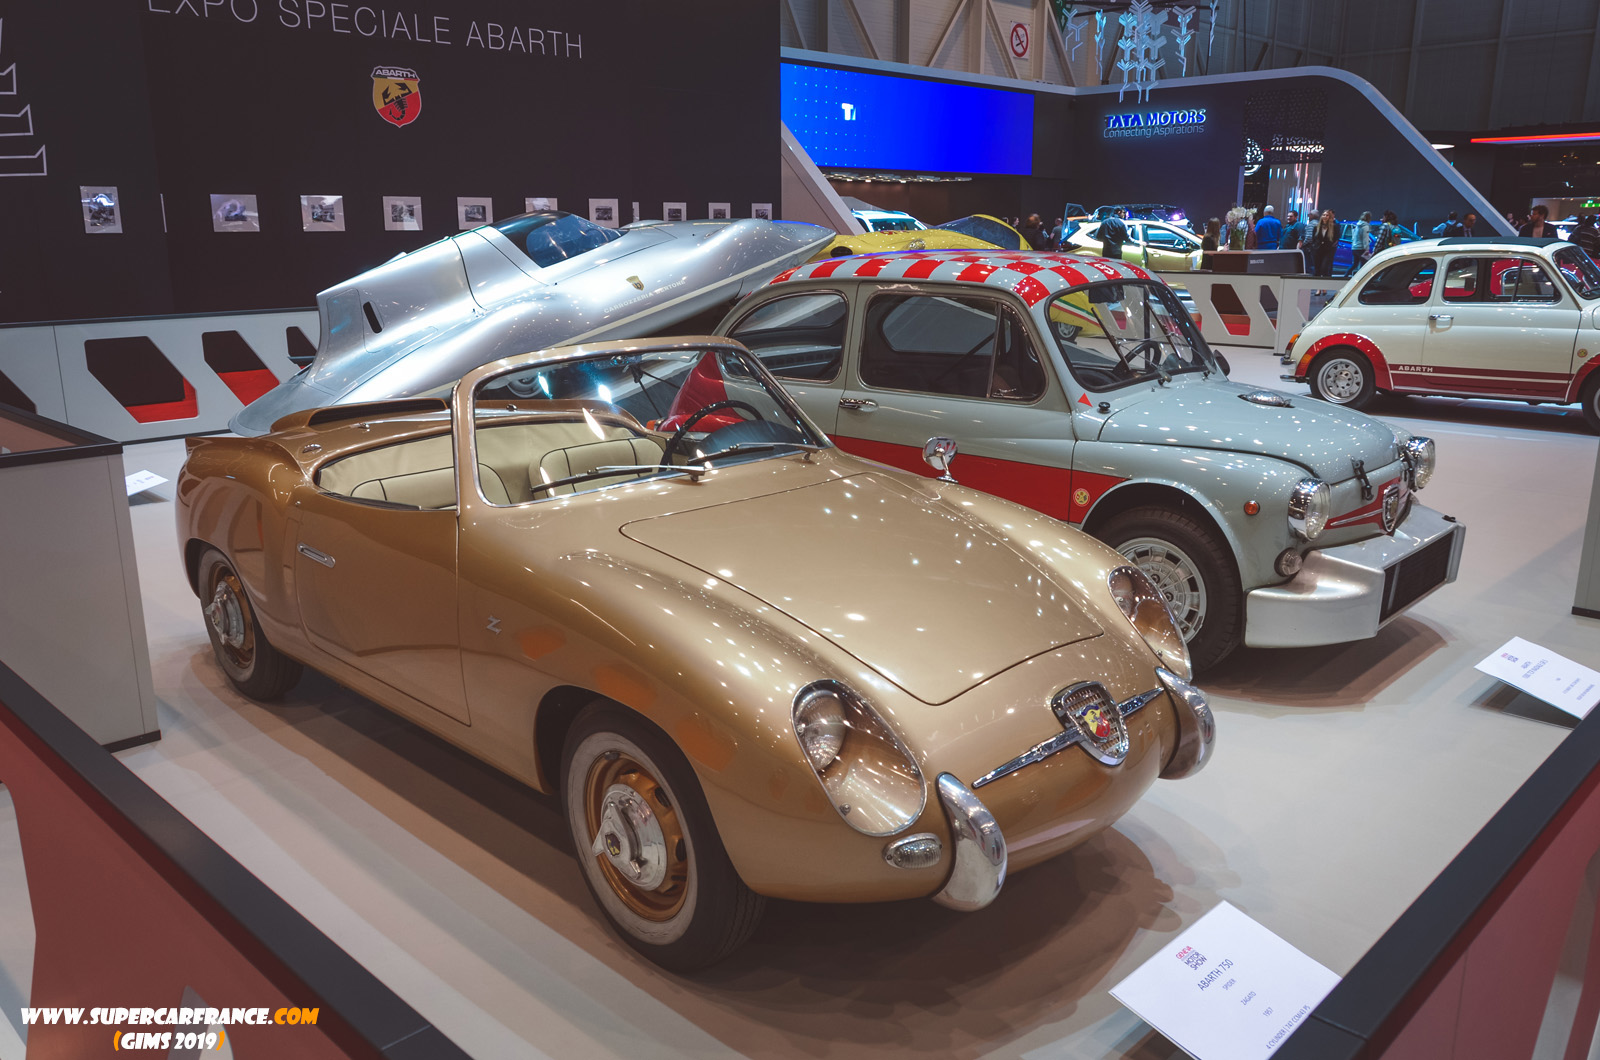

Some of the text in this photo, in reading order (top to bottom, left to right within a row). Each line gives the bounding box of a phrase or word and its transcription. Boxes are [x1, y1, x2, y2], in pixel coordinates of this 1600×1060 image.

[279, 0, 451, 45] SPECIALE
[466, 20, 582, 59] ABARTH
[375, 69, 416, 79] ABARTH
[1105, 108, 1206, 129] TATA MOTORS
[1103, 124, 1204, 138] Connecting Aspirations
[1398, 365, 1433, 373] ABARTH
[1184, 951, 1201, 967] MOTOR
[1190, 954, 1208, 971] SHOW
[1197, 958, 1234, 990] ABARTH 750
